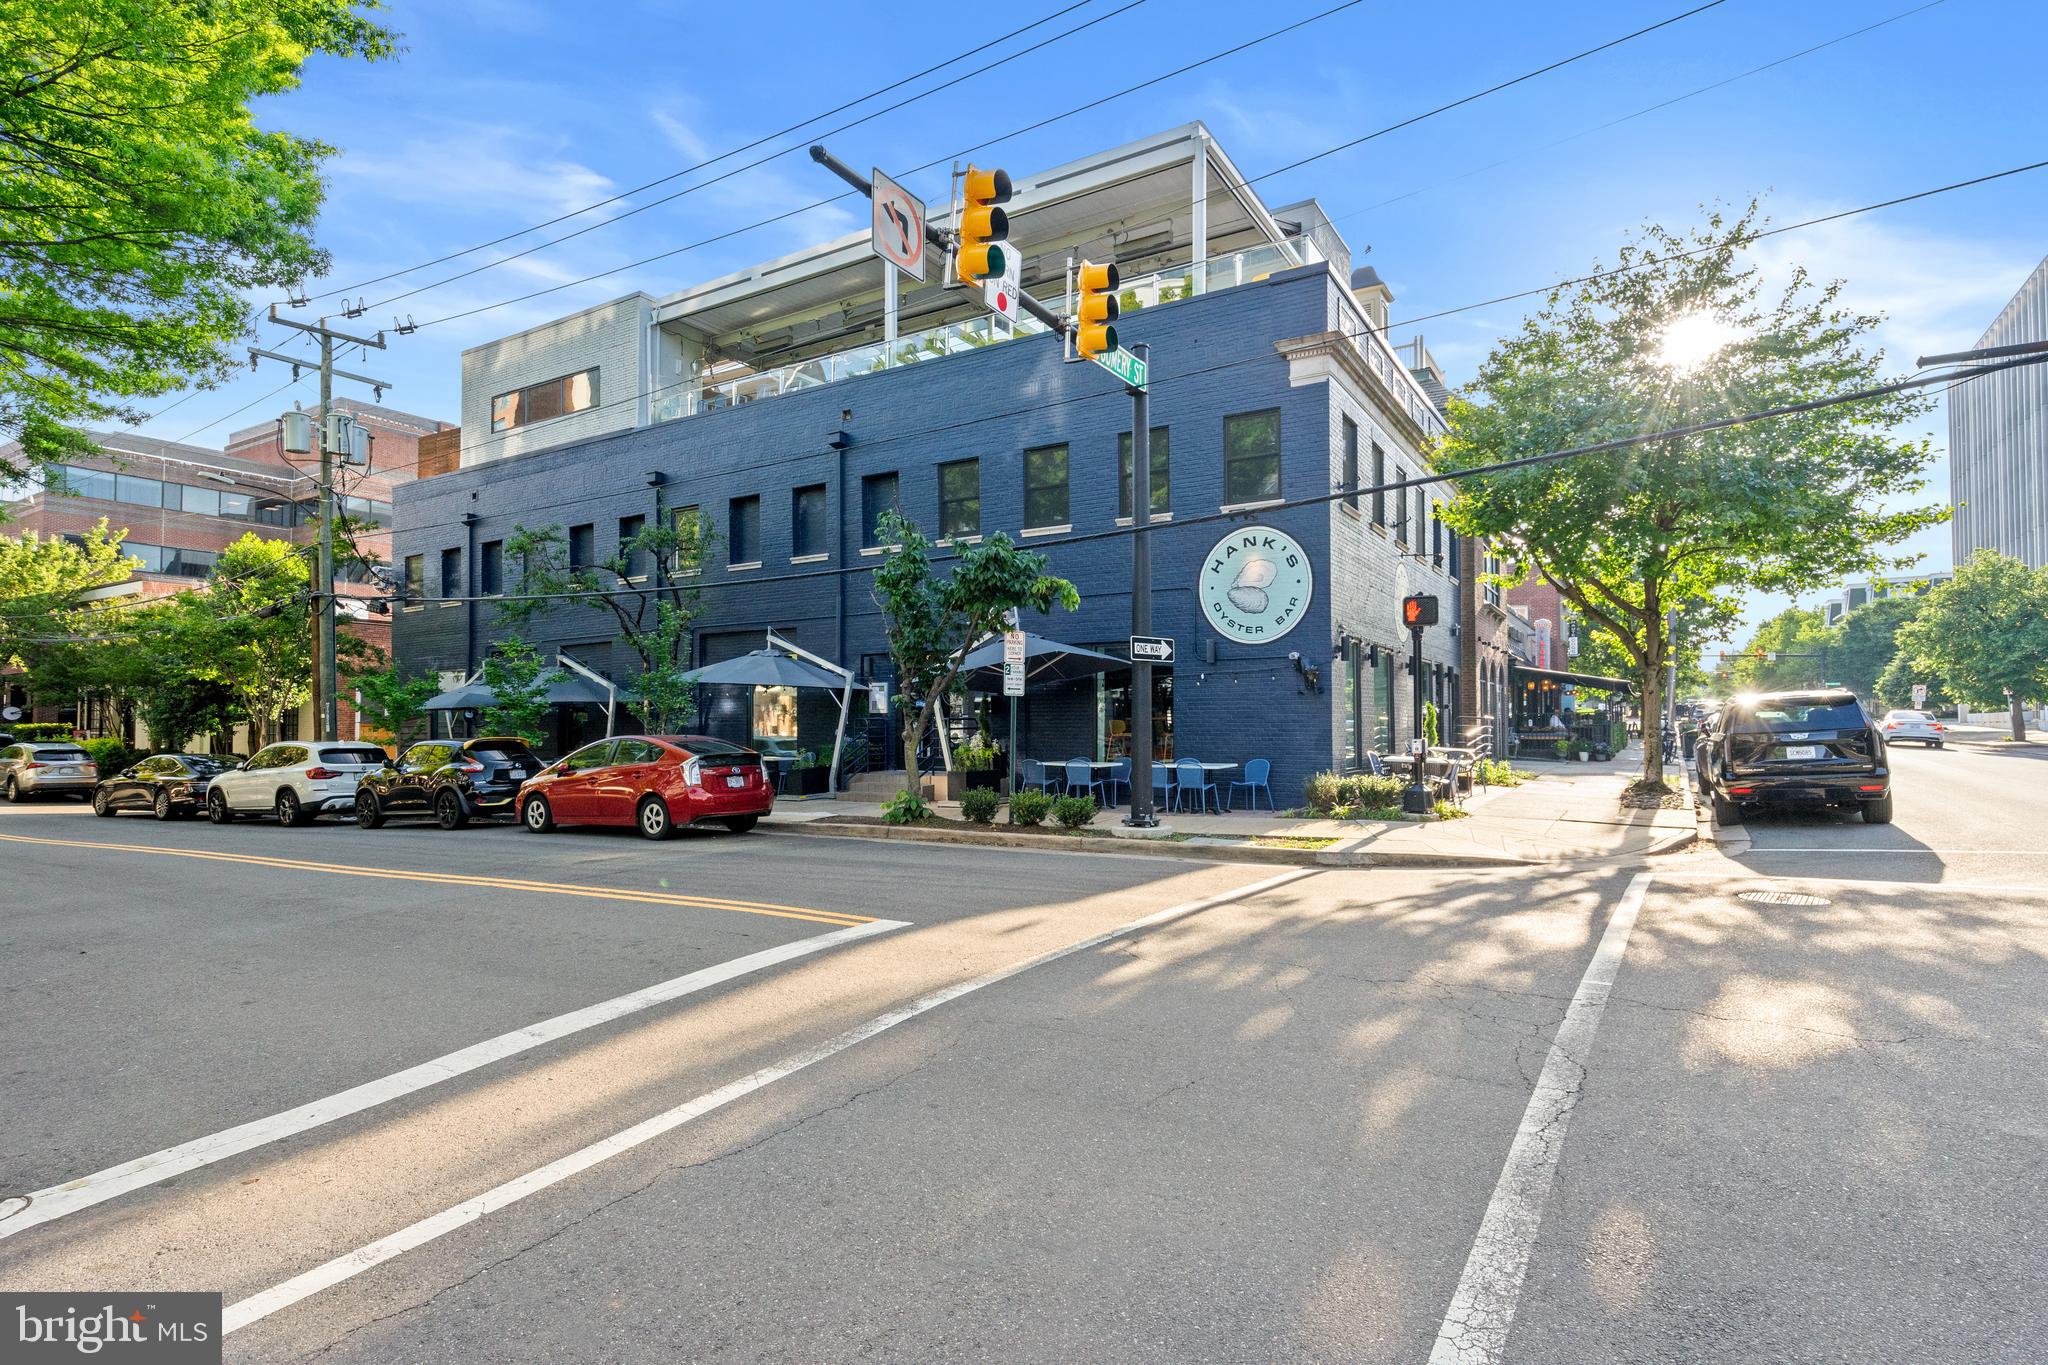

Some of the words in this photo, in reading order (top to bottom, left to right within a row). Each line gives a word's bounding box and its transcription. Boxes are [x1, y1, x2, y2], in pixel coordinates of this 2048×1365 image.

[1002, 281, 1017, 300] RED
[1134, 362, 1143, 384] ST
[1211, 536, 1298, 574] HANK'S
[1213, 602, 1264, 634] OYSTER
[1275, 596, 1298, 625] BAR
[1136, 643, 1148, 653] ONE
[1150, 645, 1162, 654] WAY
